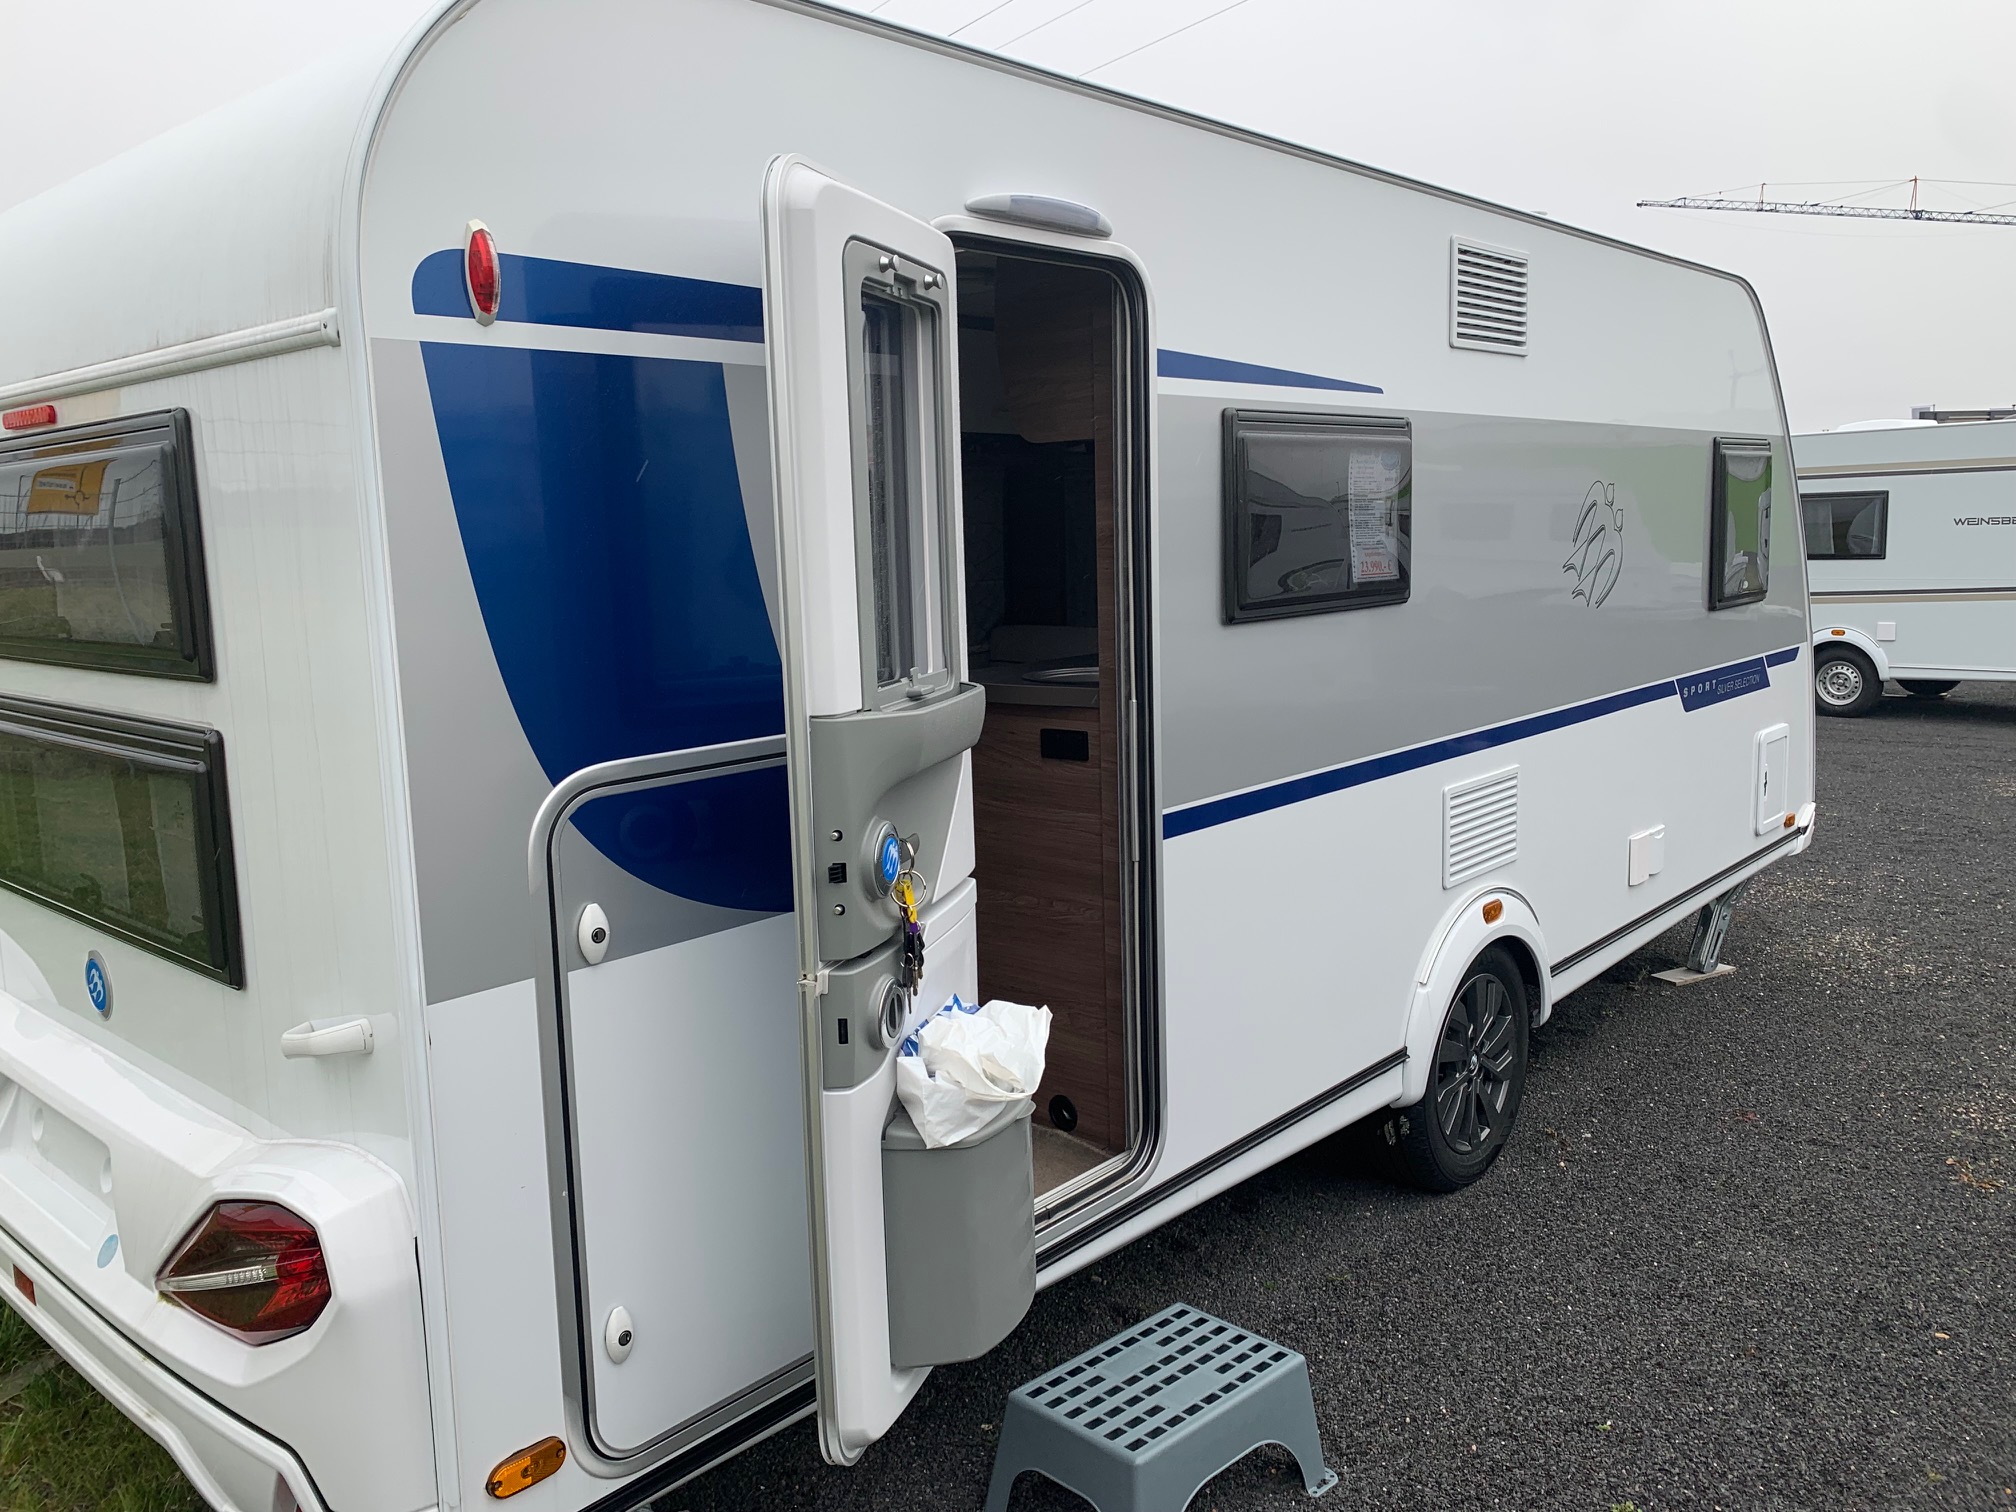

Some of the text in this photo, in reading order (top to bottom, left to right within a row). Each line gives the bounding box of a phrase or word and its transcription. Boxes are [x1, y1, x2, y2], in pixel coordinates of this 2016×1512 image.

[1683, 674, 1760, 698] SPORT SILVER SELECTION
